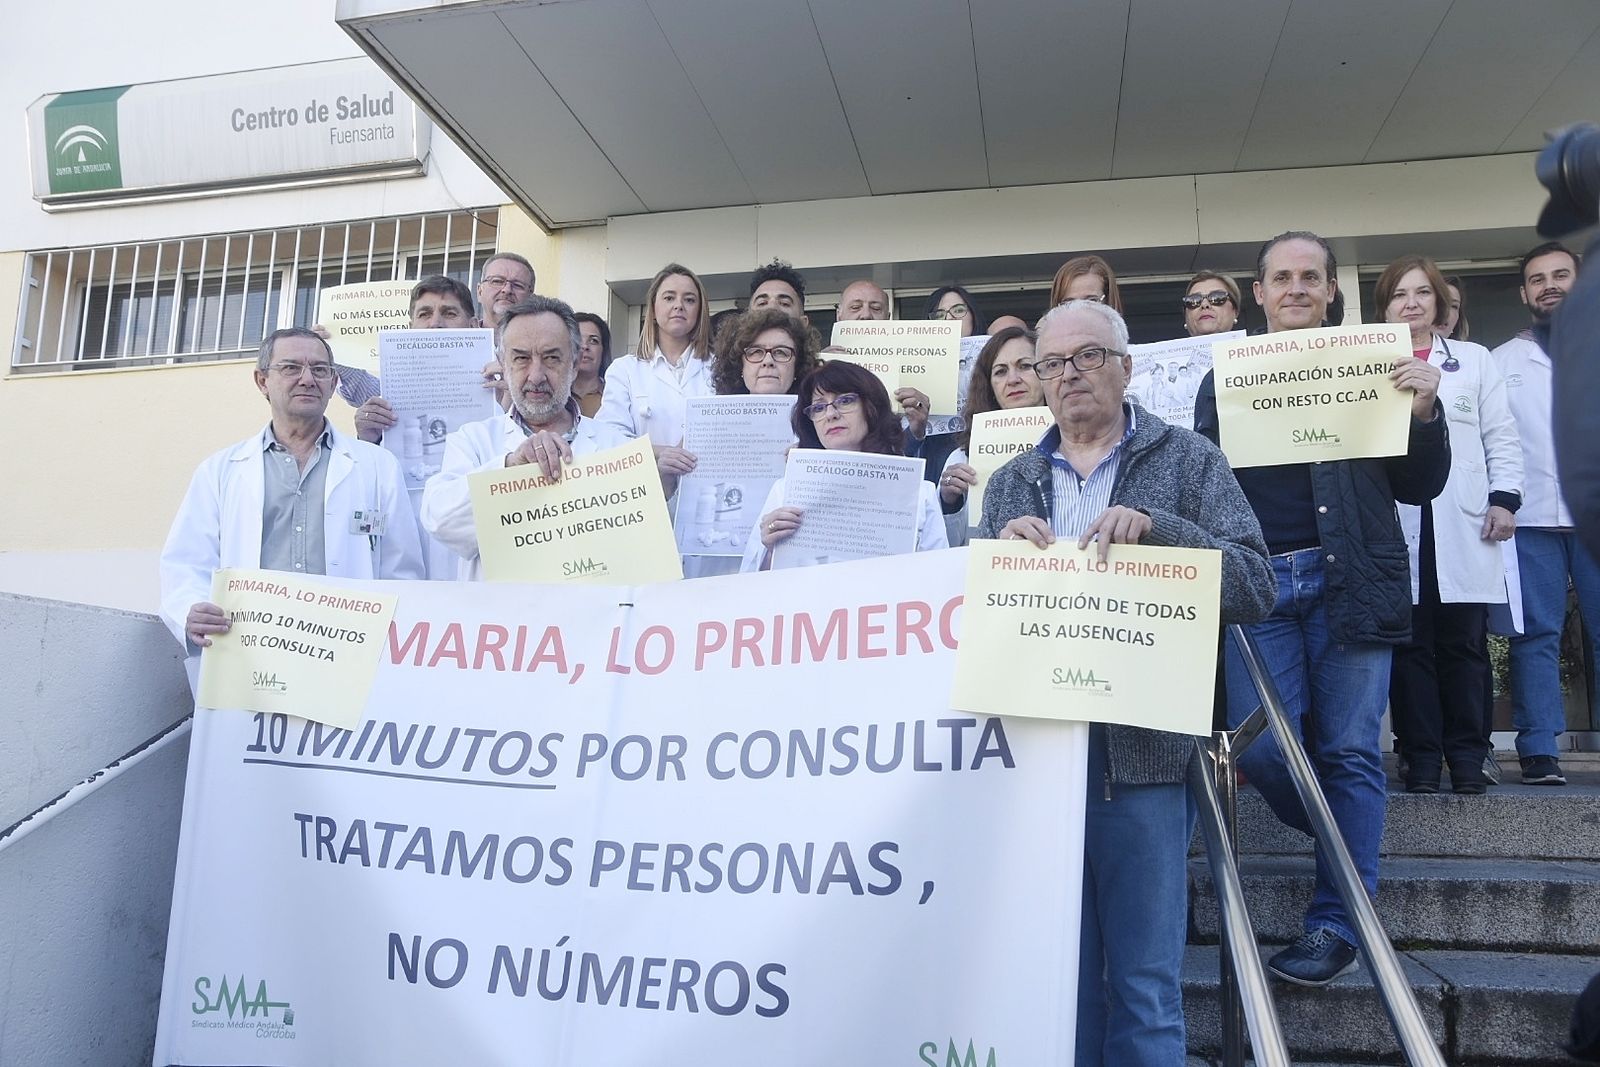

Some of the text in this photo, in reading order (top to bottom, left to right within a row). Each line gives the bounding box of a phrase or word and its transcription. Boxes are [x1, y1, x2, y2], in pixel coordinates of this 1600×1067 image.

[231, 91, 394, 132] Centro de Salud
[330, 124, 394, 146] Fuensanta
[56, 166, 72, 176] JUNTA
[74, 165, 81, 174] DE
[331, 290, 378, 302] PRIMARIA,
[380, 289, 392, 298] LO
[333, 309, 410, 320] NO MÁS ESCLAV
[340, 324, 410, 335] DCCU Y URGEN
[840, 326, 951, 337] PRIMARIA, LO PRIMERO
[396, 341, 438, 350] DECÁLOGO
[440, 341, 463, 349] BASTA
[846, 347, 947, 356] RATAMOS PERSONAS
[1228, 340, 1303, 359] PRIMARIA,
[1307, 337, 1326, 350] LO
[1330, 332, 1397, 347] PRIMERO
[901, 365, 926, 374] EROS
[1225, 362, 1396, 388] EQUIPARACIÓN SALARIA
[1252, 388, 1378, 411] CON RESTO CC.AA
[701, 407, 742, 416] DECÁLOGO
[743, 407, 767, 415] BASTA
[984, 415, 1050, 429] PRIMARIA,
[1293, 428, 1337, 443] SMA
[978, 443, 1034, 456] EQUIPAR
[490, 452, 643, 496] PRIMAR, LO PRIMERO
[806, 464, 899, 481] DECÁLOGO BASTA YA
[500, 484, 647, 526] NO MÁS ESCLAVOS EN
[514, 510, 644, 547] DCCU Y URGENCIAS
[562, 558, 604, 575] SMA
[991, 556, 1197, 580] PRIMARIA, LO PRIMERO
[228, 579, 382, 614] PRIMARIA, LO PRIMERO
[986, 592, 1197, 621] SUSTITUCIÓN DE TODAS
[231, 608, 366, 644] MÍNIMO 10 MINUTOS
[1020, 622, 1155, 647] LAS AUSENCIAS
[241, 634, 335, 662] POR CONSULTA
[388, 620, 586, 685] MARIA,
[606, 625, 675, 676] LO
[1052, 667, 1108, 687] SMA
[246, 711, 1017, 782] 10 MINUTOS POR CONSULTA
[294, 812, 574, 888] TRATAMOS
[388, 932, 790, 1019] NO NÚMEROS
[192, 974, 290, 1019] SMA
[191, 1019, 285, 1030] Sindicato Médico Andaluz
